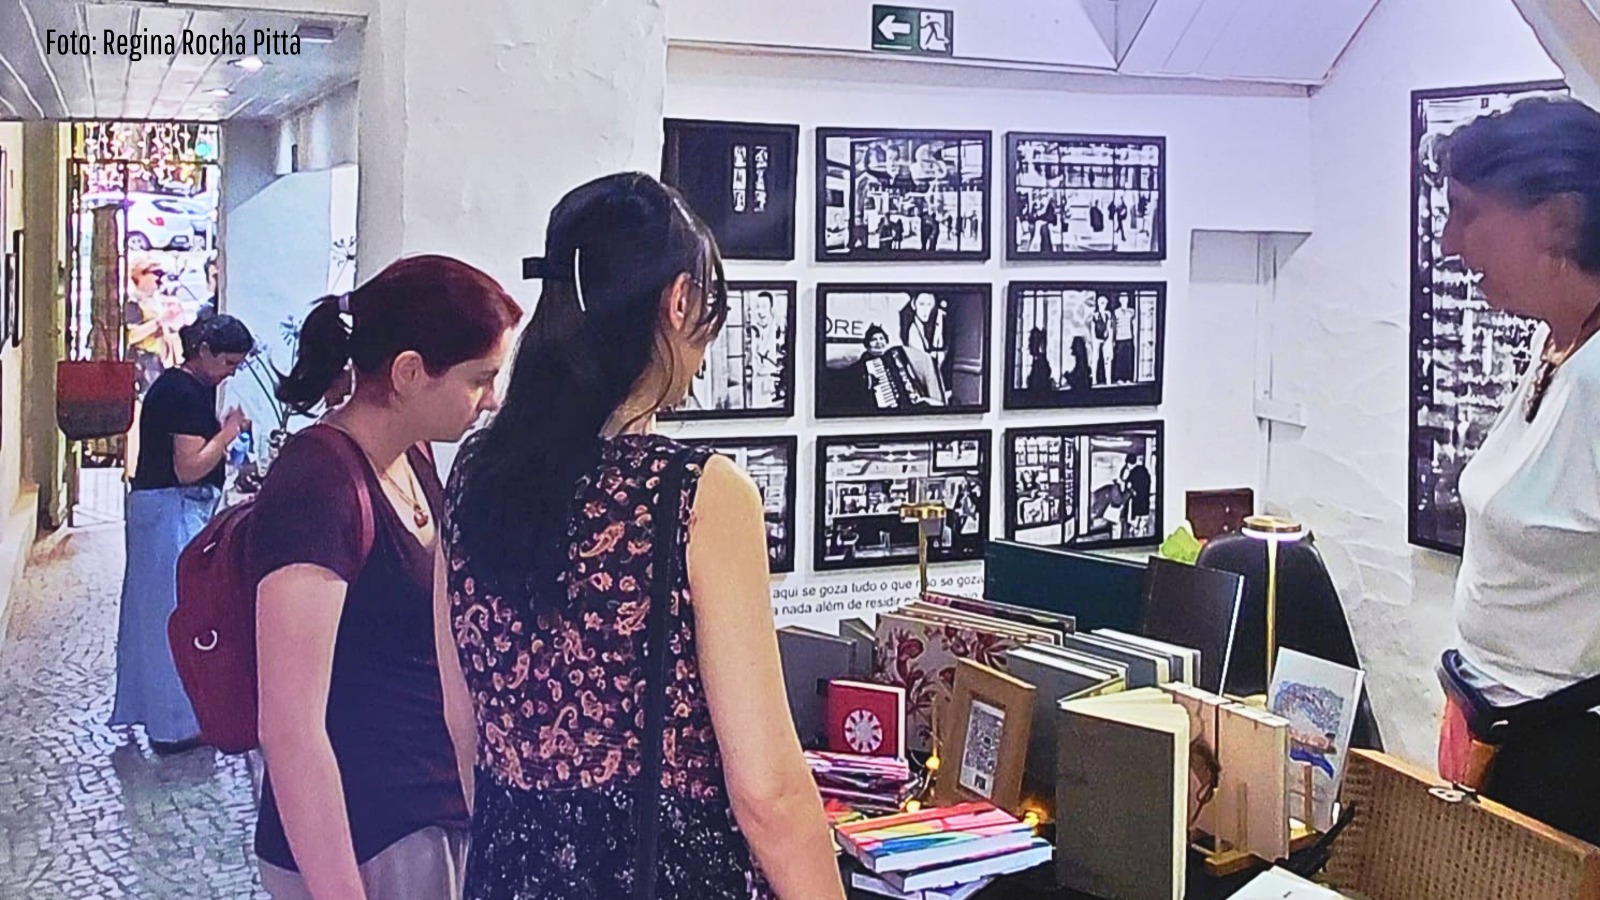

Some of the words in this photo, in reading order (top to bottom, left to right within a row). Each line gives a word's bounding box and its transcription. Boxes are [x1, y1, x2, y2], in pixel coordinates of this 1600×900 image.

[773, 588, 798, 600] aqui
[802, 587, 816, 597] se
[820, 584, 848, 598] goza
[851, 581, 877, 593] tudo
[880, 582, 888, 591] o
[891, 580, 912, 592] que
[782, 602, 812, 615] nada
[847, 599, 862, 610] de
[865, 596, 900, 609] residir
